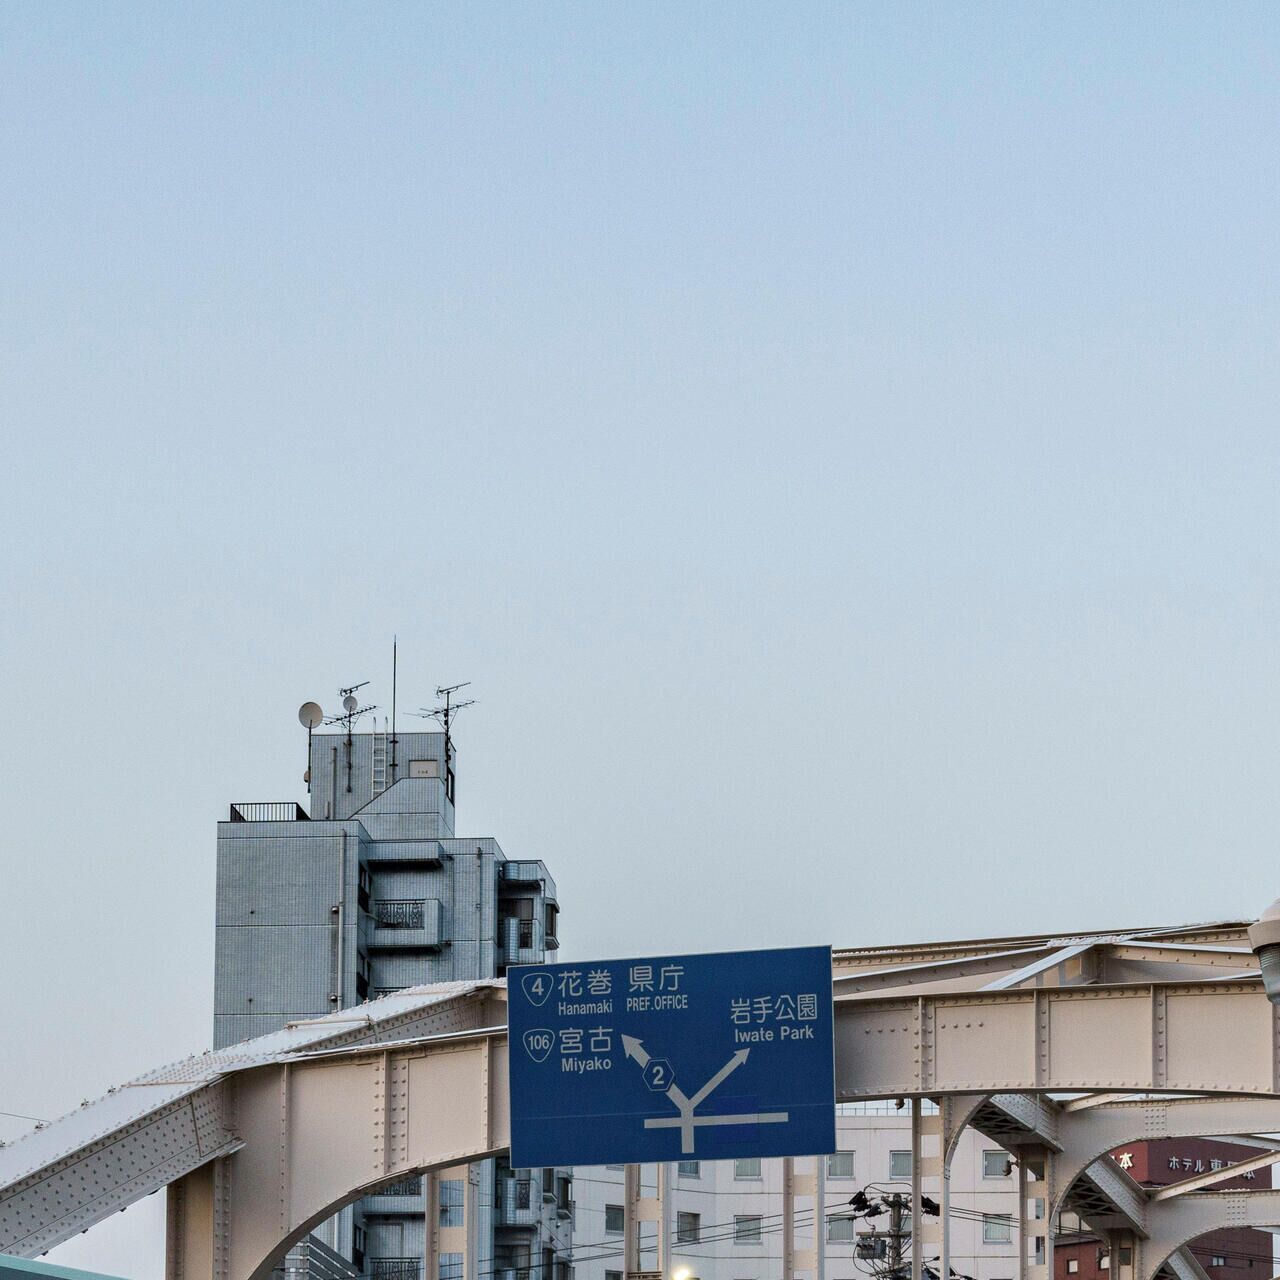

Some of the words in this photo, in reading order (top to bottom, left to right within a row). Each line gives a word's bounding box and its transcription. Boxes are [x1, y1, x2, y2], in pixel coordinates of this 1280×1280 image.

[531, 978, 544, 996] 4
[558, 969, 612, 998] 花巻
[629, 964, 685, 992] 県庁
[558, 1001, 613, 1016] Hanamaki
[626, 994, 688, 1012] PREF.OFFICE
[730, 993, 817, 1024] 岩手公園
[528, 1034, 550, 1050] 106
[559, 1026, 614, 1053] 宮古
[734, 1027, 774, 1043] Iwate
[780, 1025, 814, 1041] Park
[561, 1057, 612, 1074] Miyako
[651, 1066, 664, 1085] 2
